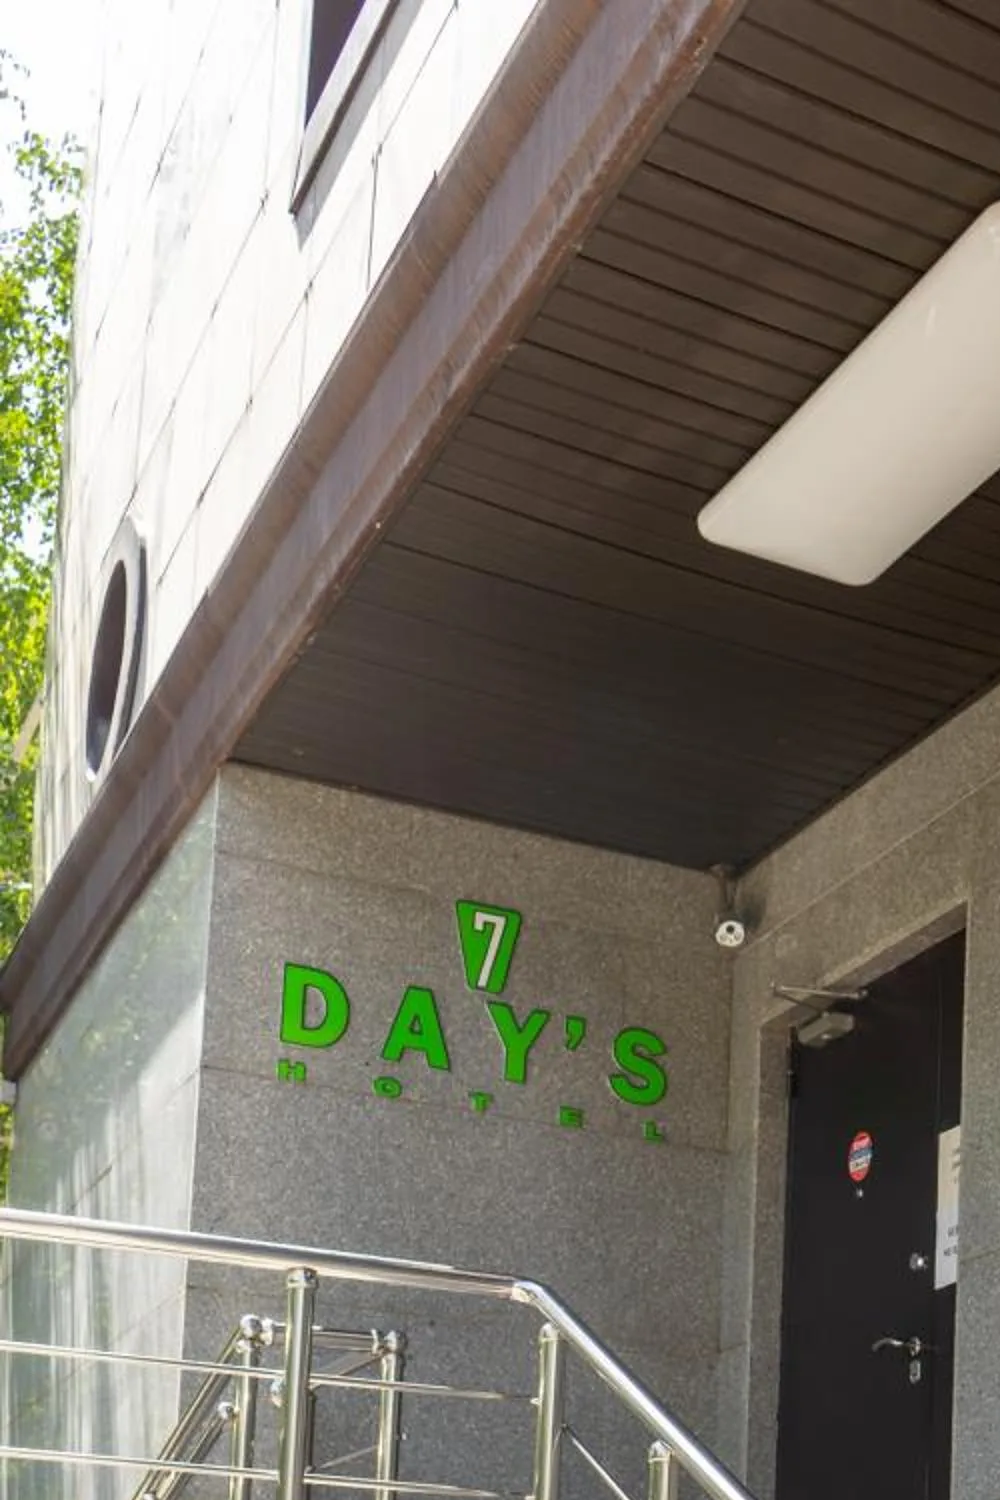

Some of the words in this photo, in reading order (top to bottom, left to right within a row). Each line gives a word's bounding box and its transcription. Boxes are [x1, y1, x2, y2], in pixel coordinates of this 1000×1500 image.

[472, 909, 508, 991] 7
[279, 961, 668, 1107] DAY'S
[276, 1057, 665, 1144] HOTEL
